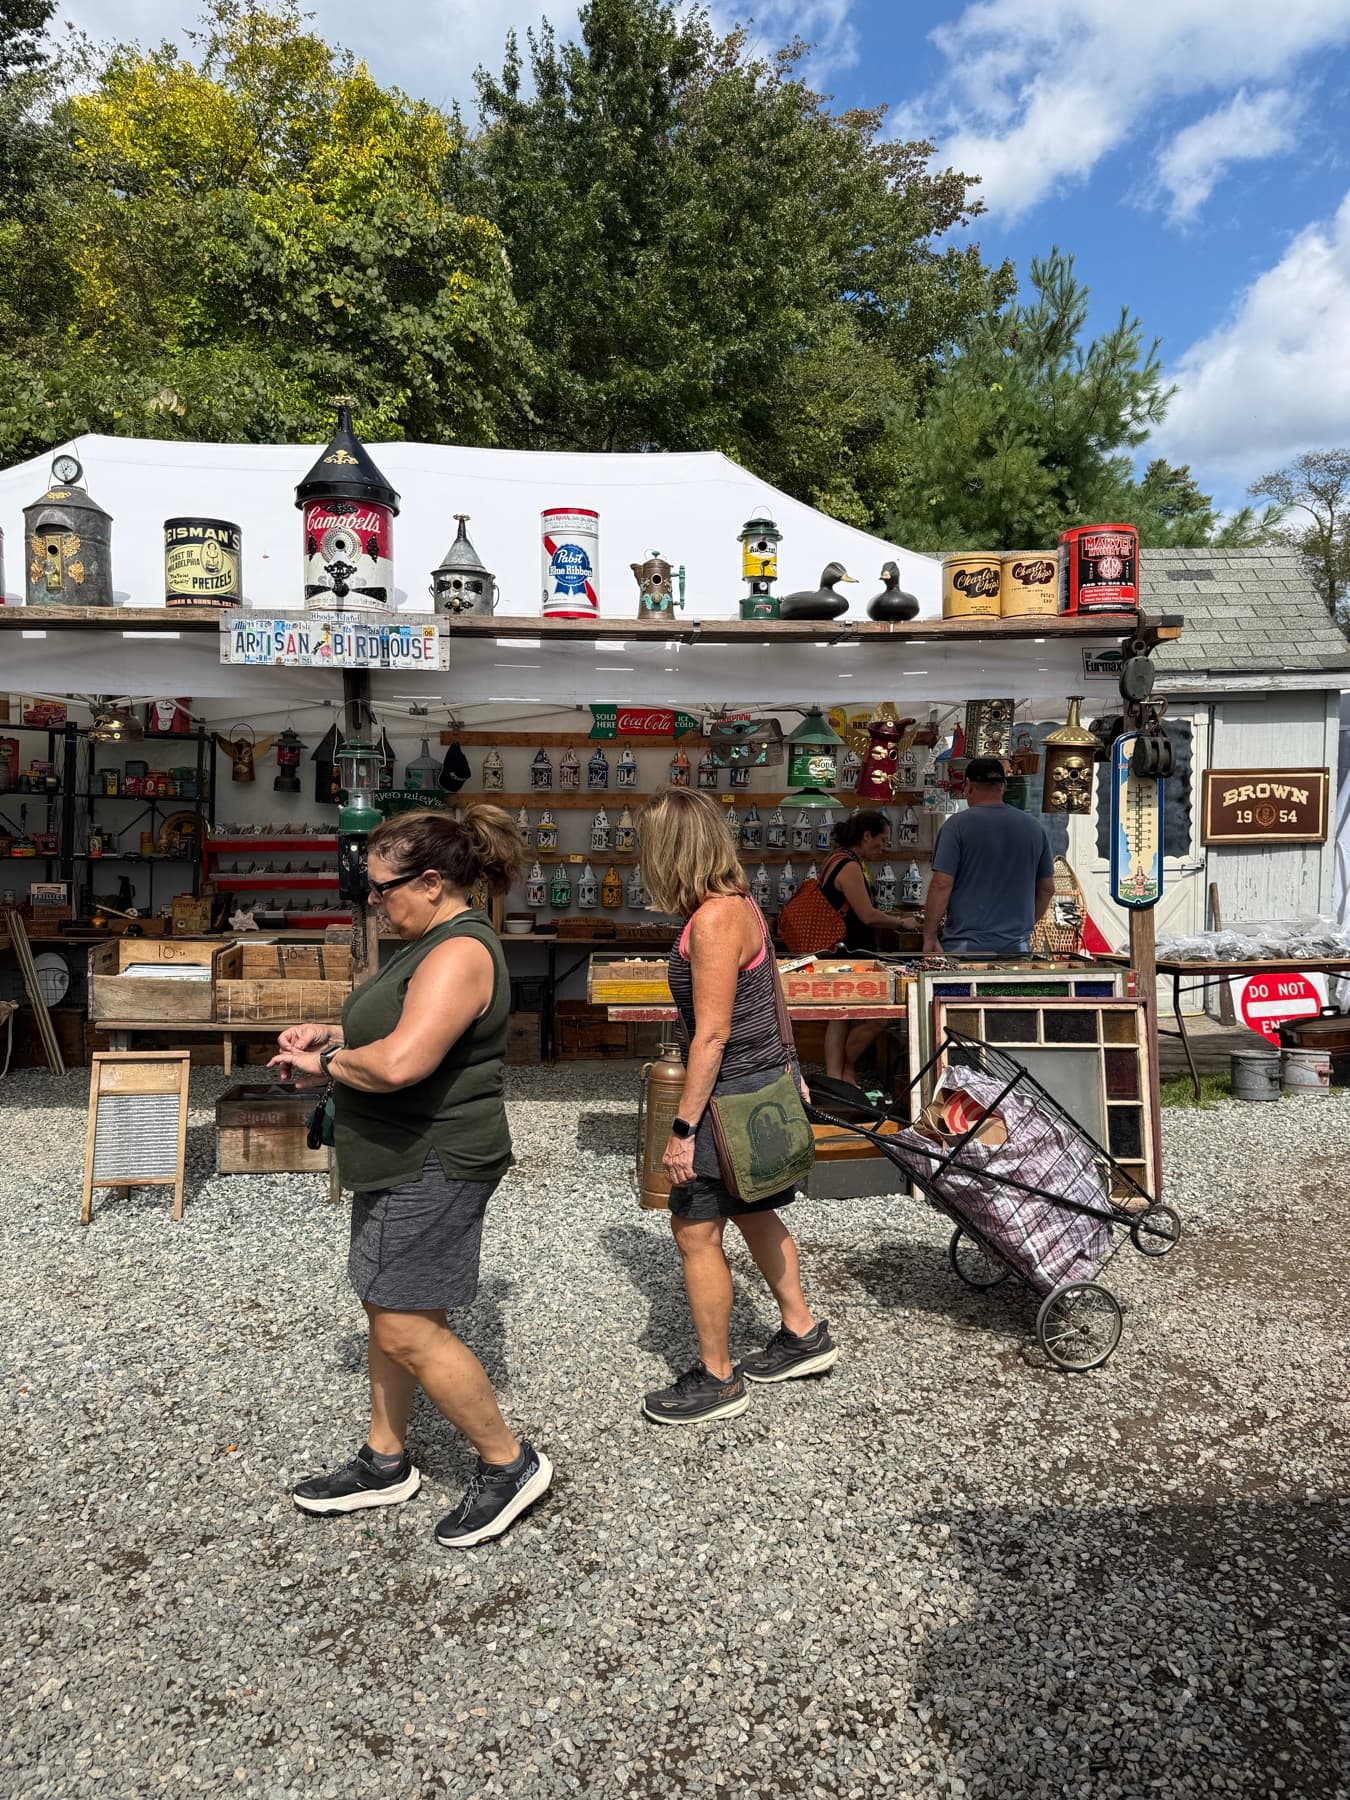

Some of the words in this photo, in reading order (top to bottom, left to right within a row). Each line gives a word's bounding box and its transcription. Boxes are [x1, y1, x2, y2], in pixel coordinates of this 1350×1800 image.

[307, 506, 380, 533] Campbell's
[1085, 537, 1131, 550] MARVEL
[557, 549, 583, 563] Pabst
[549, 565, 565, 576] Blue
[566, 565, 592, 577] Ribbon
[1015, 561, 1047, 578] Charles
[1030, 569, 1052, 581] Chips
[192, 570, 231, 589] PRETZELS
[957, 570, 994, 589] Charles
[976, 579, 1000, 592] Chips
[235, 631, 310, 656] ARTISAN
[333, 633, 434, 660] BIRDHOUSE
[1086, 660, 1122, 672] Eurmax
[1222, 783, 1309, 807] BROWN
[1236, 810, 1252, 823] 19
[1279, 810, 1298, 823] 54
[788, 981, 888, 998] PEPSI
[1248, 984, 1269, 998] DO
[1277, 982, 1305, 997] NOT
[515, 1460, 538, 1490] HOKA
